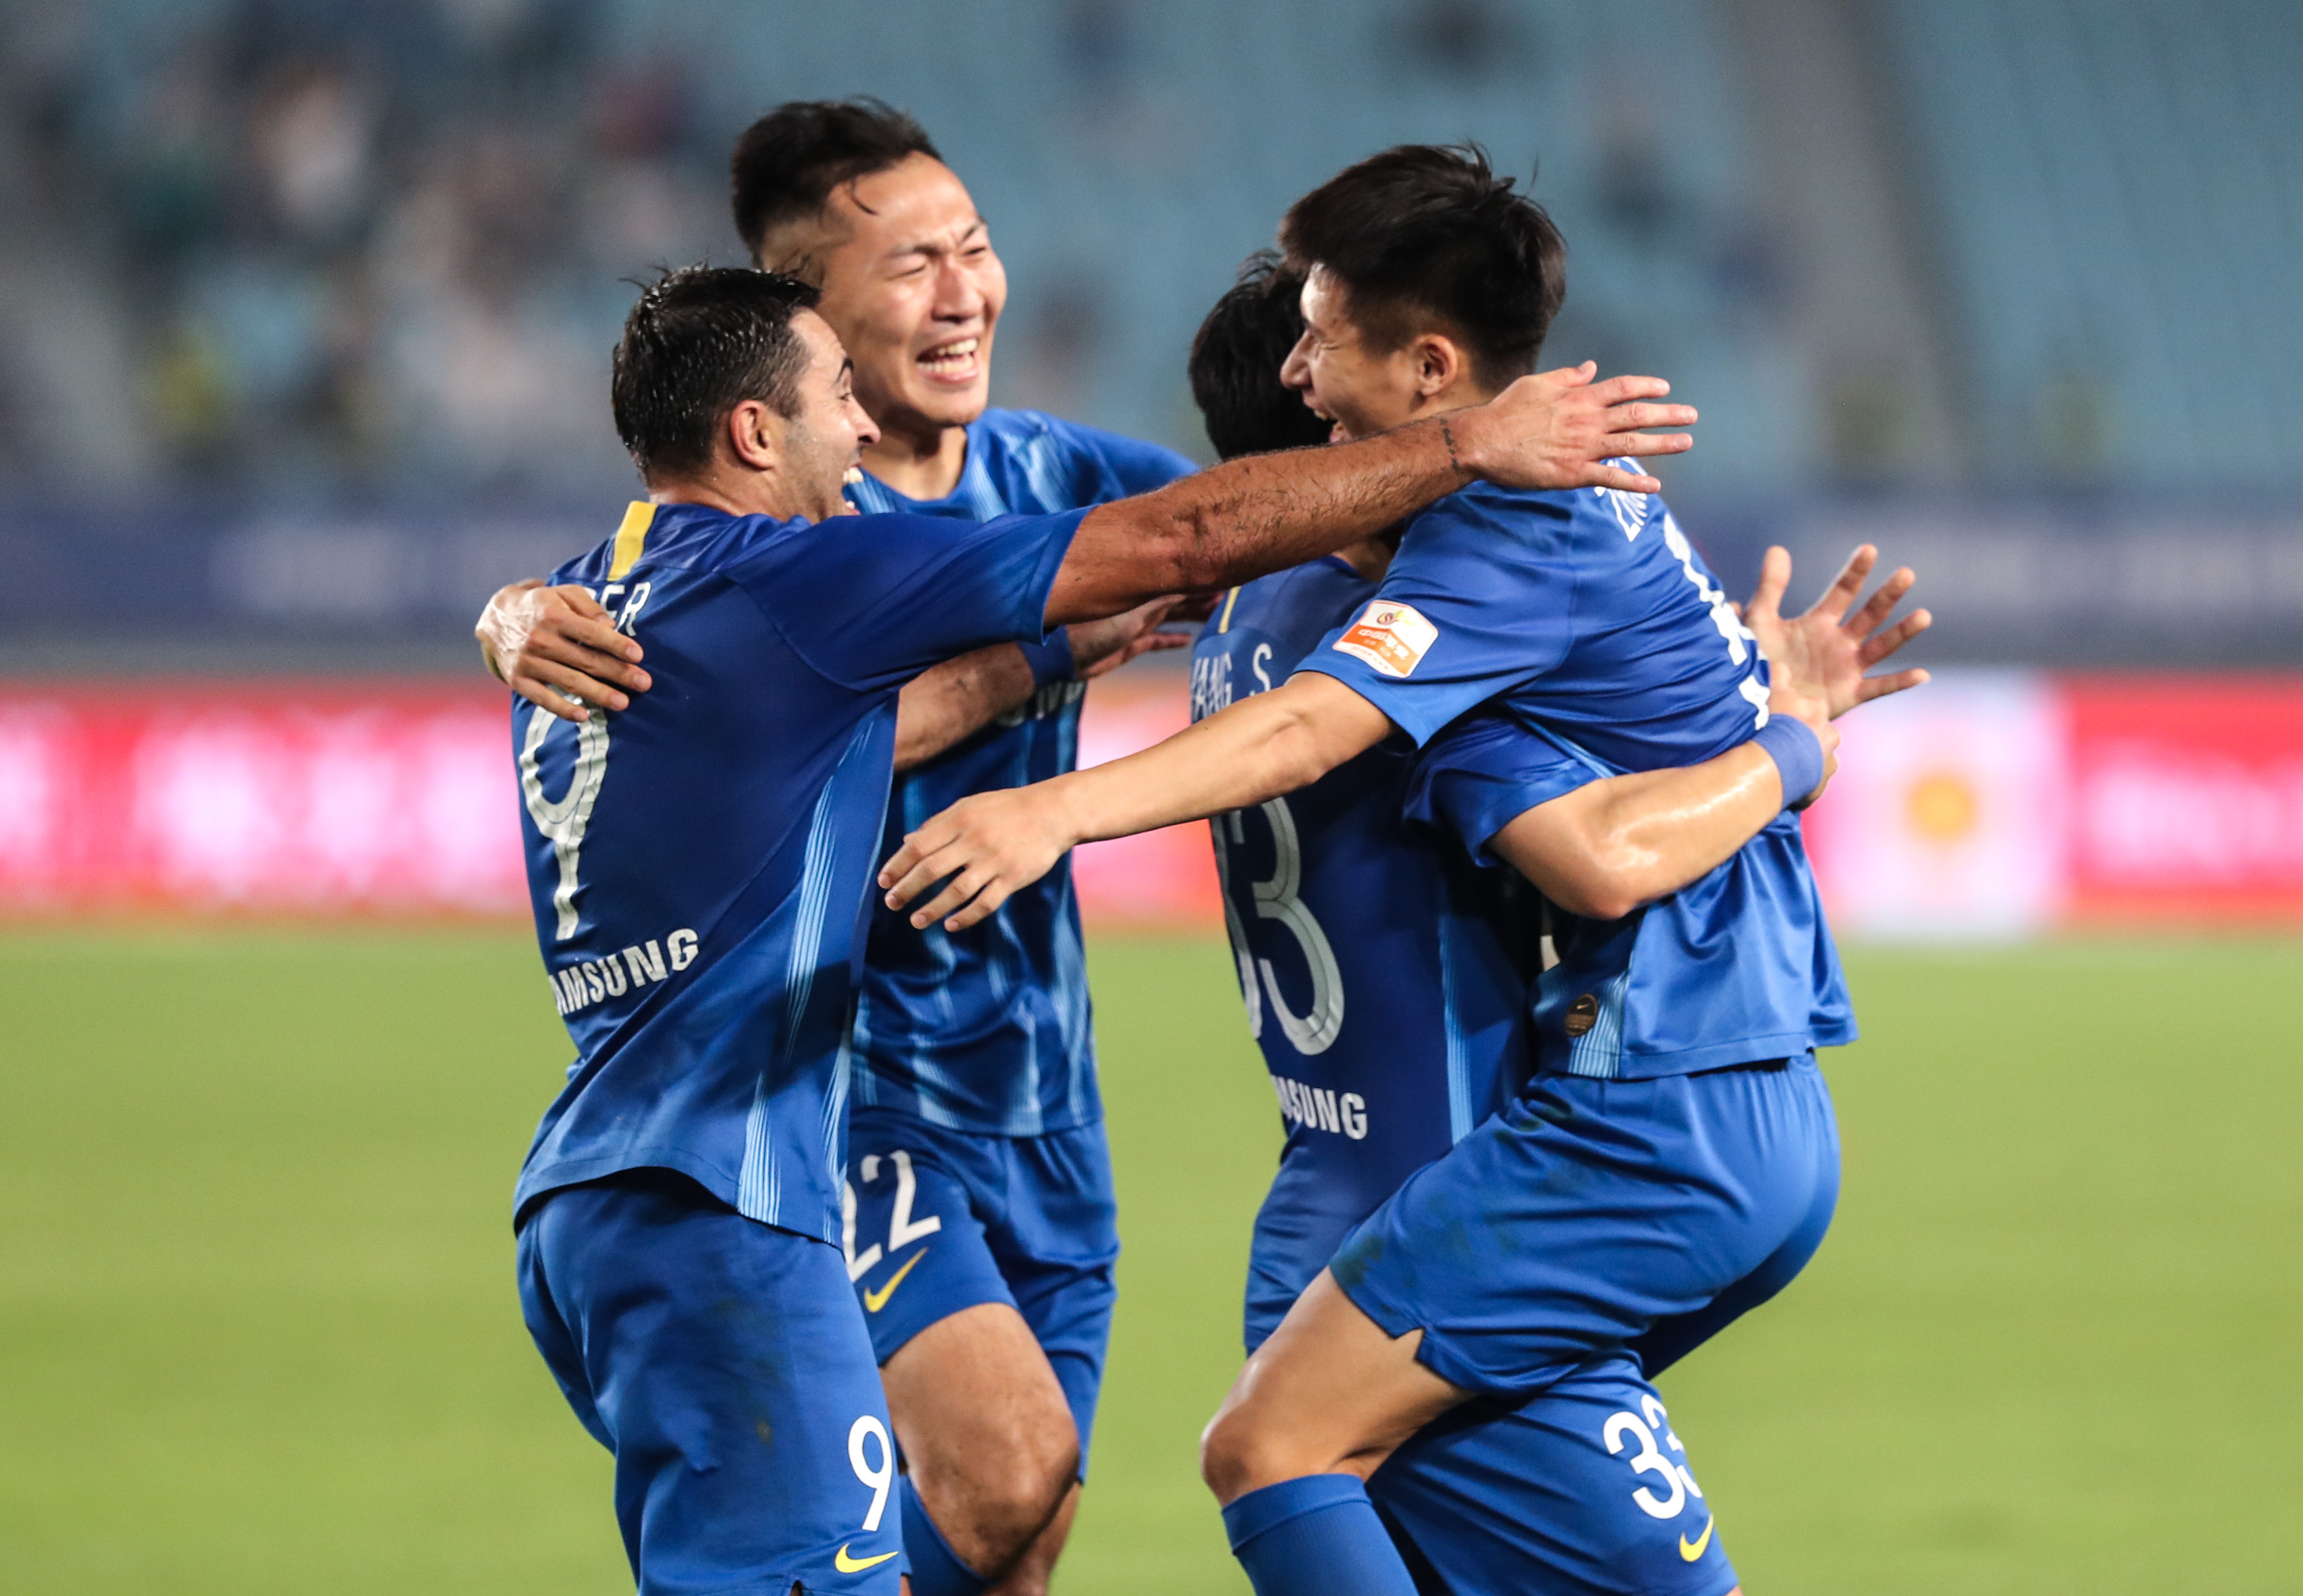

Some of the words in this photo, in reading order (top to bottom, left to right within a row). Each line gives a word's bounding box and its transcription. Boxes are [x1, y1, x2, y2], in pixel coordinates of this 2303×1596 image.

[584, 581, 651, 637] ER
[519, 684, 610, 941] 9
[549, 927, 699, 1017] AMSUNG
[841, 1149, 942, 1283] 22
[848, 1415, 893, 1532] 9
[1602, 1393, 1703, 1520] 33
